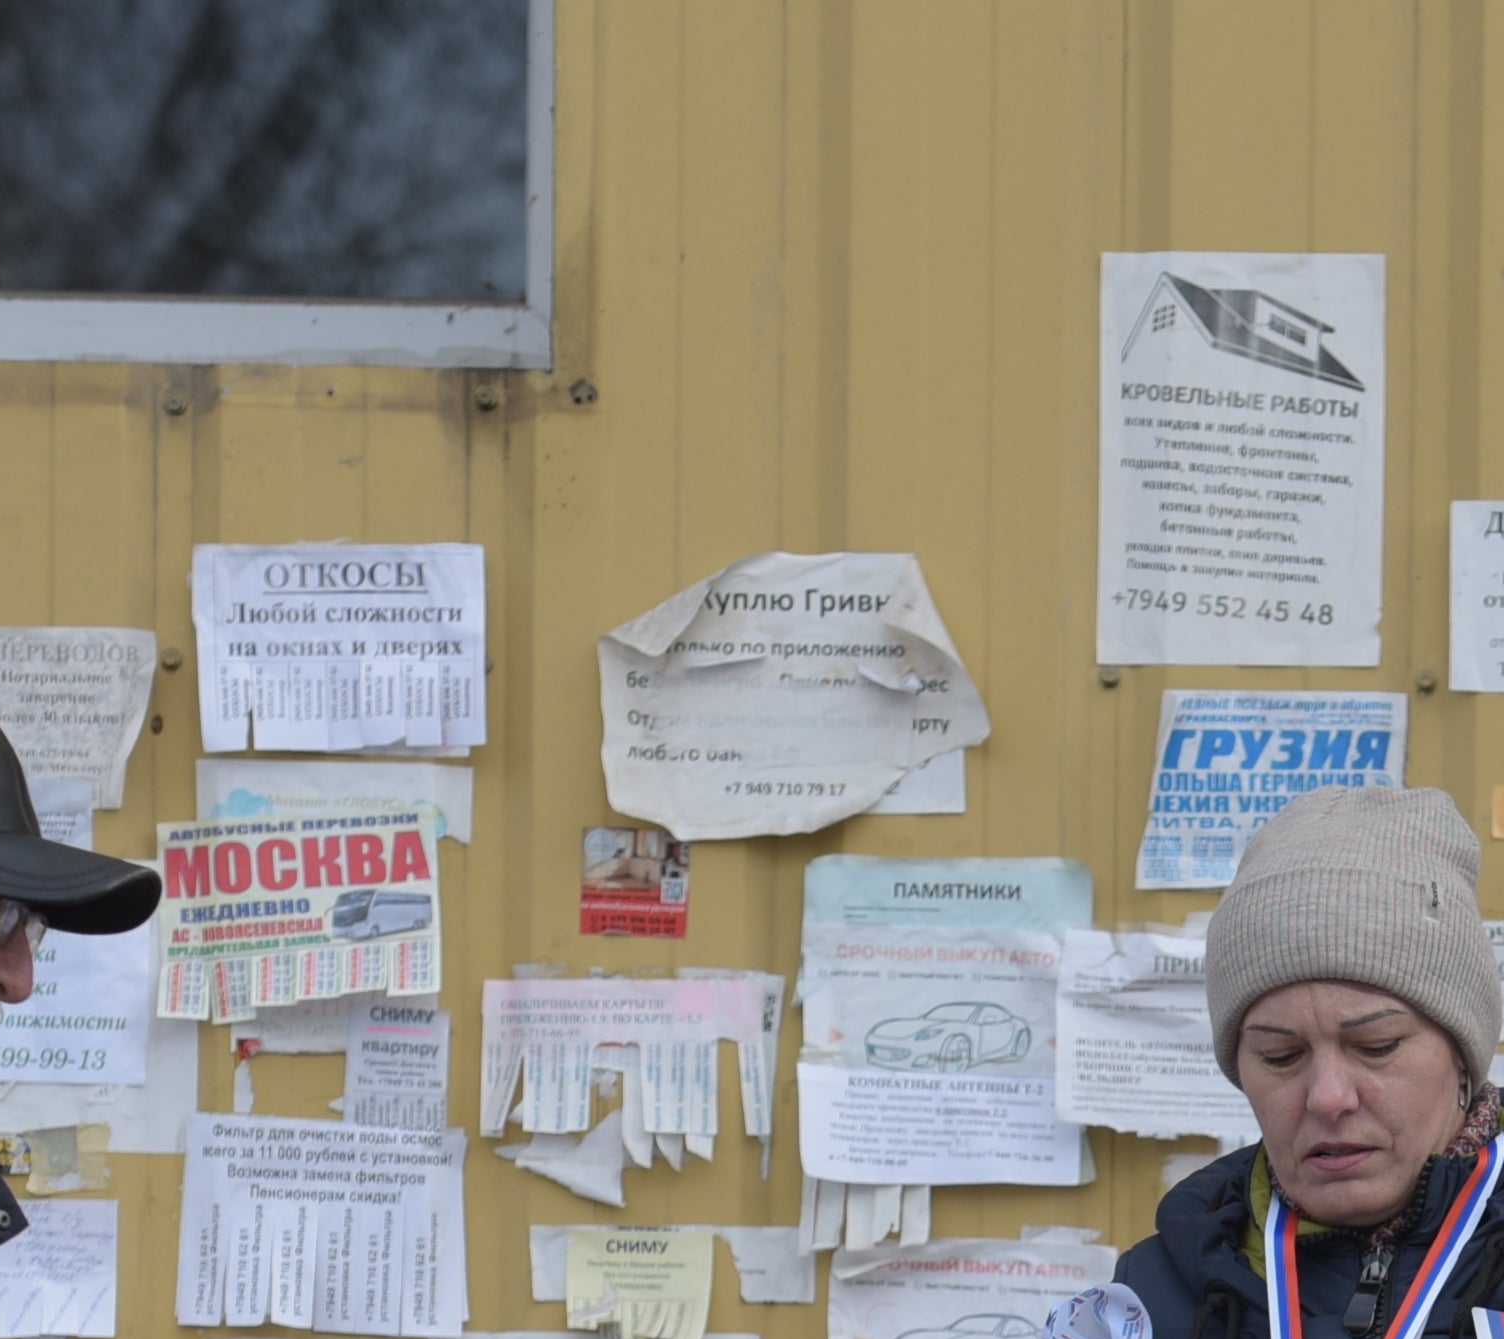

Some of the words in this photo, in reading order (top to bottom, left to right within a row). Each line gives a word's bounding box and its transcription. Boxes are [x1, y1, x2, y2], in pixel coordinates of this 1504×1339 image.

[1121, 383, 1266, 411] КРОВЕЛЬНЫЕ
[1270, 395, 1359, 418] РАБОТЫ
[263, 561, 428, 590] ОТКОСЫ
[226, 603, 317, 625] Любой
[324, 605, 463, 624] сложности
[1112, 589, 1188, 613] +7949
[1197, 593, 1247, 617] 552
[1255, 599, 1289, 622] 45
[1299, 603, 1334, 625] 48
[228, 642, 257, 657] на
[265, 641, 343, 657] окнах
[351, 642, 366, 656] и
[374, 641, 463, 661] дверях
[770, 639, 906, 662] приложению
[1163, 729, 1392, 771] ГРУЗИЯ
[164, 831, 431, 899] МОСКВА
[892, 880, 1022, 902] ПАМЯТНИКИ
[180, 898, 310, 924] ЕЖЕДНЕВНО
[605, 1238, 669, 1255] СНИМУ
